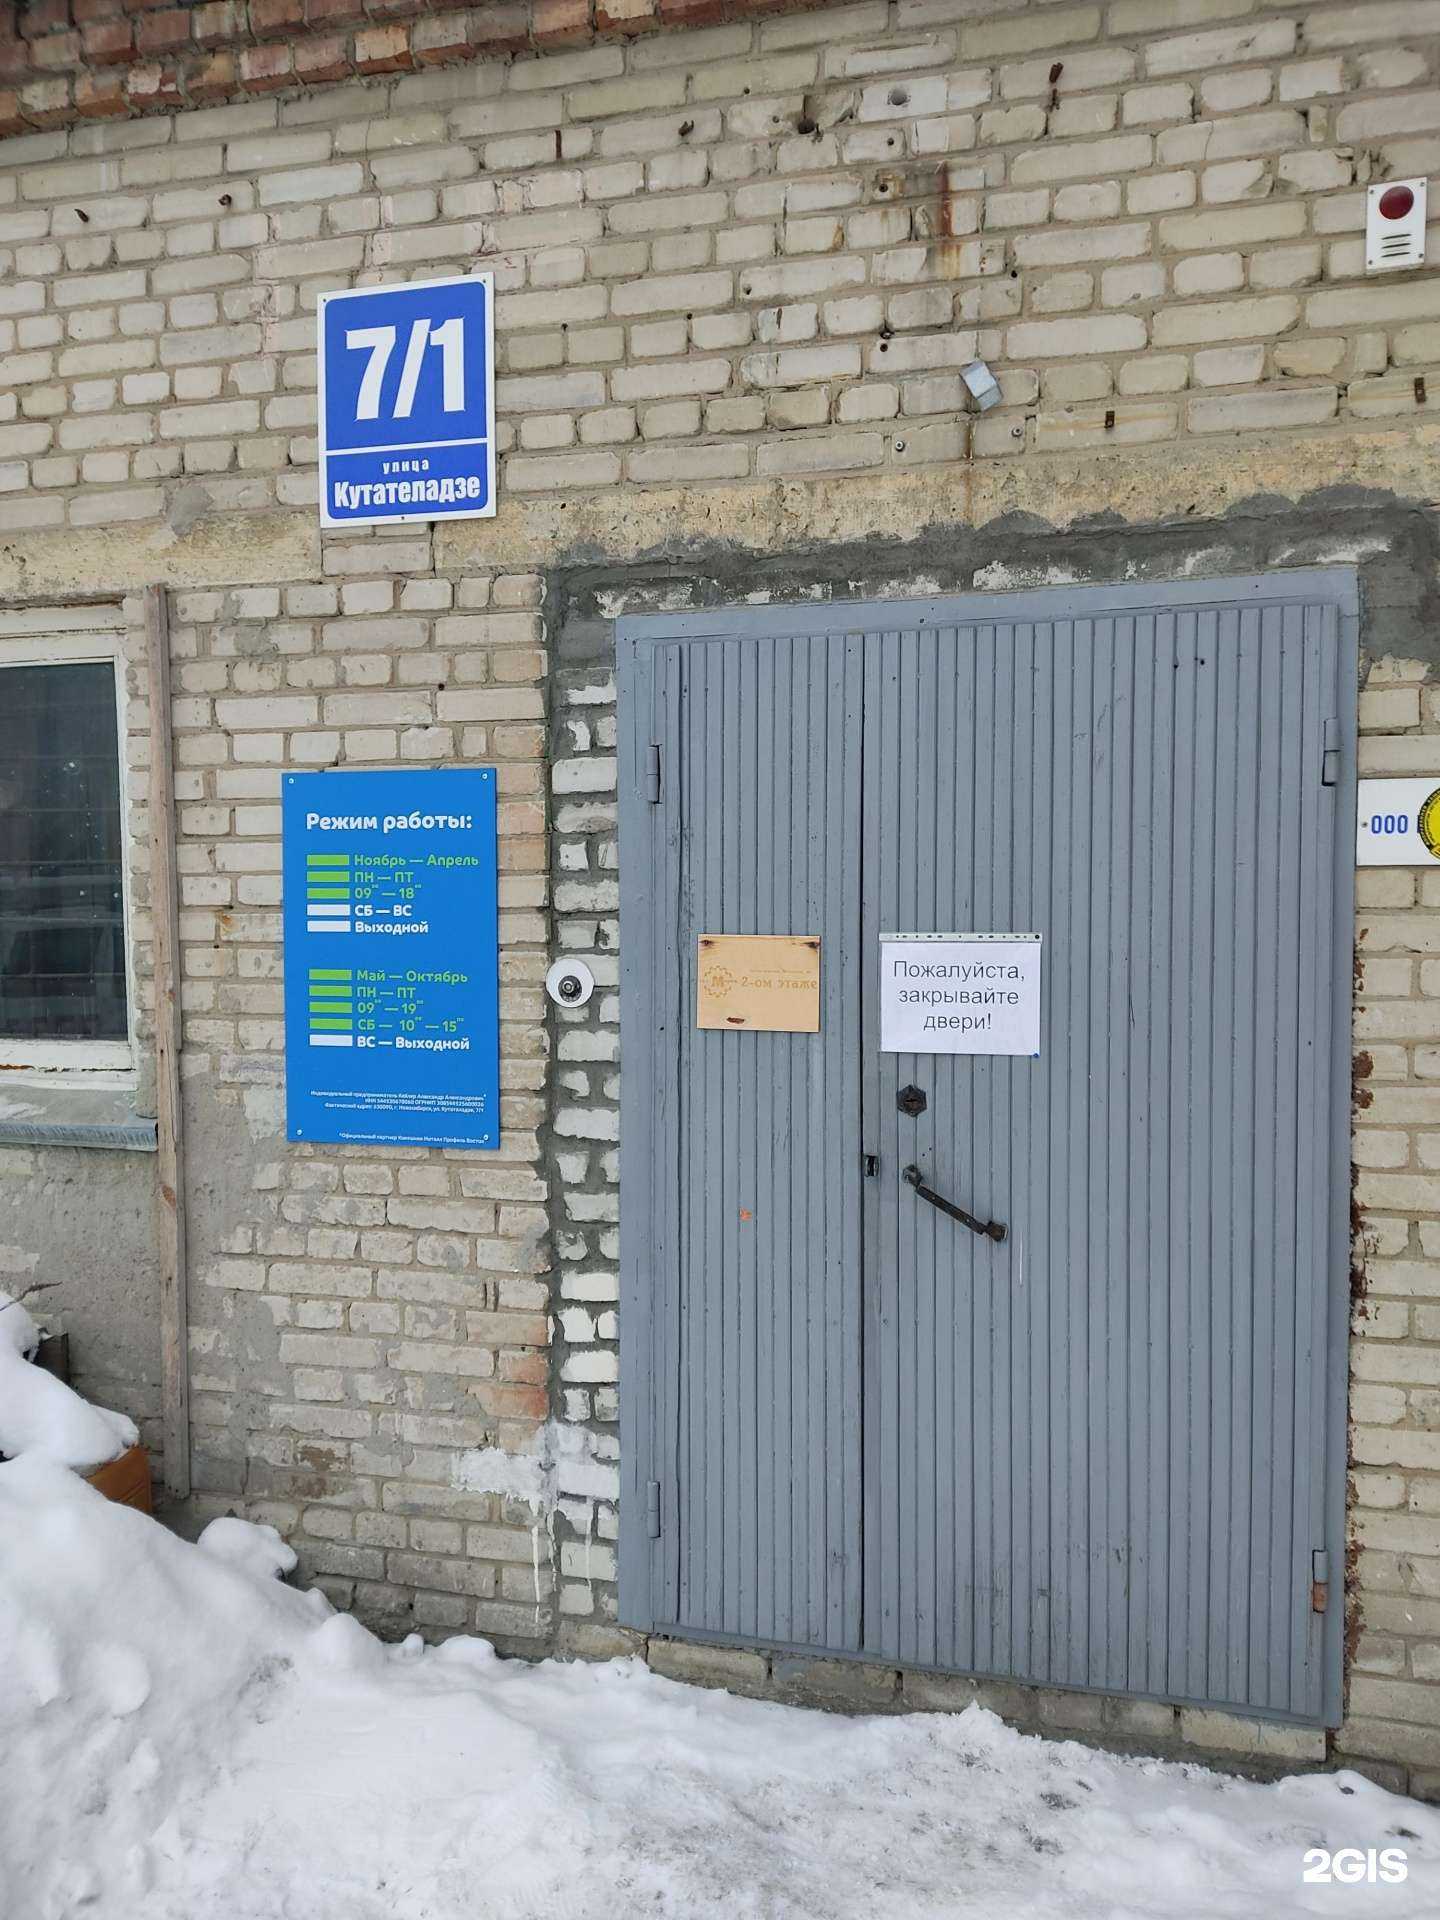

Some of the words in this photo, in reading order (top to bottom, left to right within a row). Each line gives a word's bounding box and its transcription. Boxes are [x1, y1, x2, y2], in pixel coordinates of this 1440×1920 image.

[344, 317, 466, 422] 7/1
[383, 459, 429, 474] улица
[334, 476, 480, 509] Кутателадзе
[306, 813, 378, 831] Режим
[383, 811, 472, 833] работы:
[354, 854, 406, 868] Ноябрь
[426, 854, 479, 868] Апрель
[354, 871, 374, 883] ПН
[394, 871, 414, 883] ПТ
[354, 904, 373, 916] СБ
[393, 904, 412, 917] ВС
[355, 920, 429, 935] Выходной
[357, 970, 385, 982] Май
[406, 970, 468, 985] Октябрь
[894, 961, 1025, 982] Пожалуйста,
[741, 976, 772, 988] 2-ом
[356, 986, 376, 998] ПН
[397, 987, 416, 998] ПТ
[899, 987, 1019, 1007] закрывайте
[358, 1019, 375, 1030] СБ
[923, 1013, 991, 1034] двери!
[357, 1036, 375, 1048] ВС
[395, 1037, 470, 1051] Выходной
